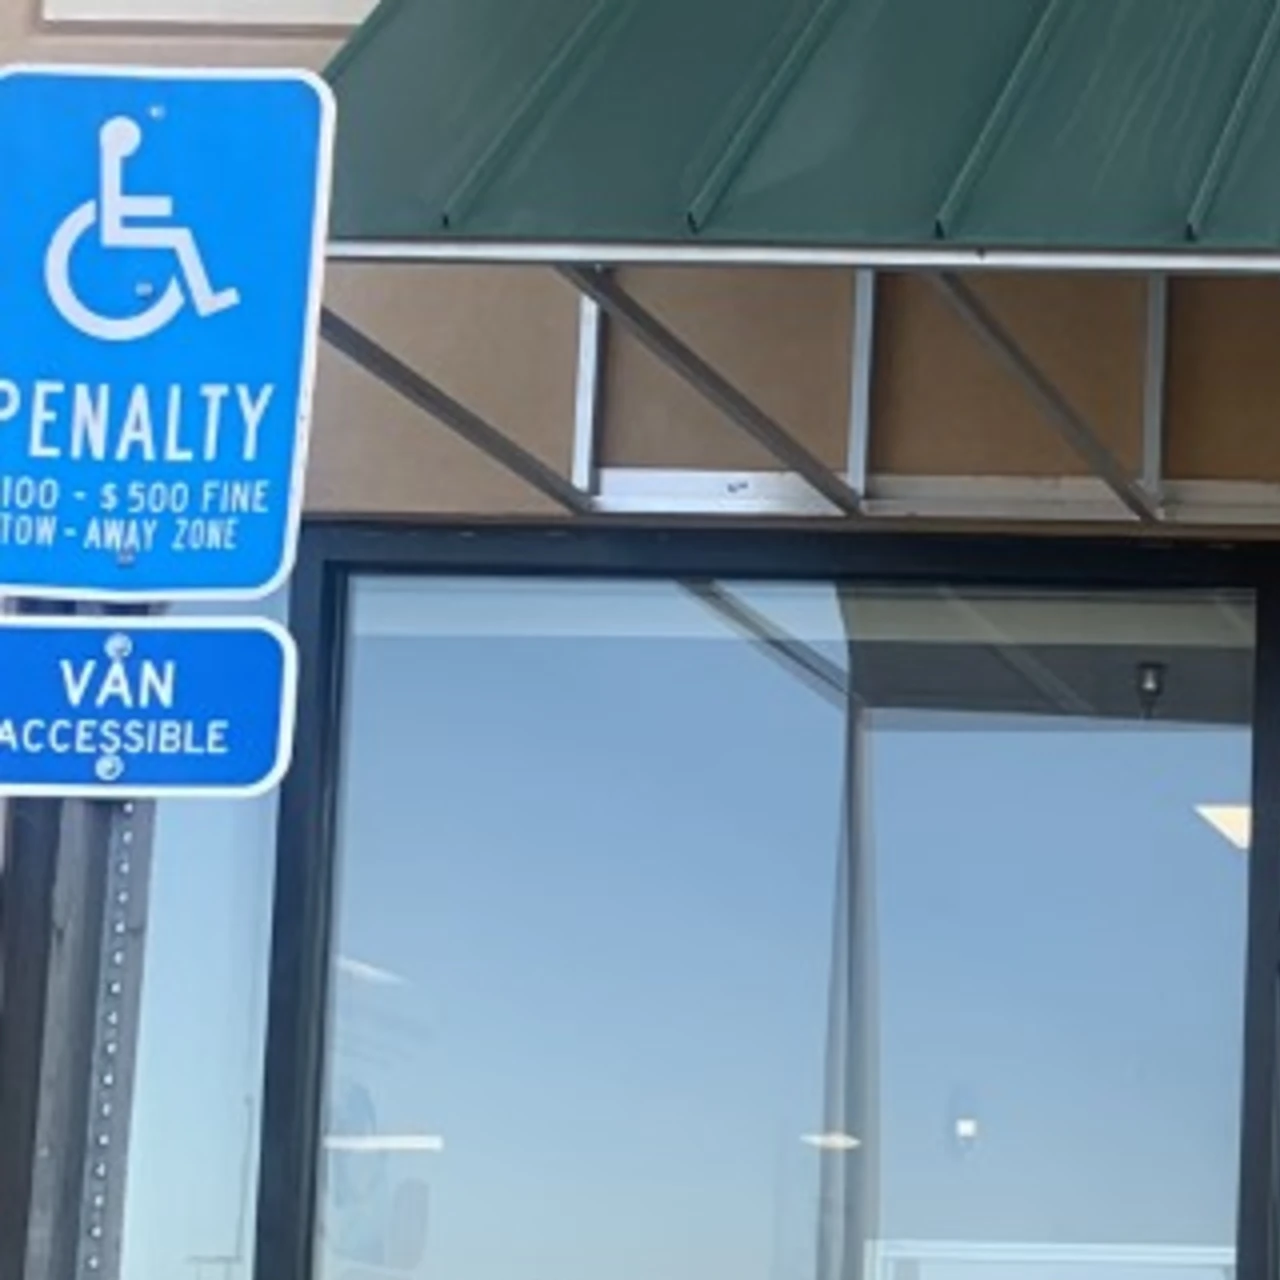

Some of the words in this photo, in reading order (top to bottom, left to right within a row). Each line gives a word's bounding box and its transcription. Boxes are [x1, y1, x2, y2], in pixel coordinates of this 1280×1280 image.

[202, 479, 270, 513] FINE
[171, 518, 240, 549] ZONE
[59, 659, 175, 708] VAN
[0, 718, 230, 754] ACCESSIBLE
